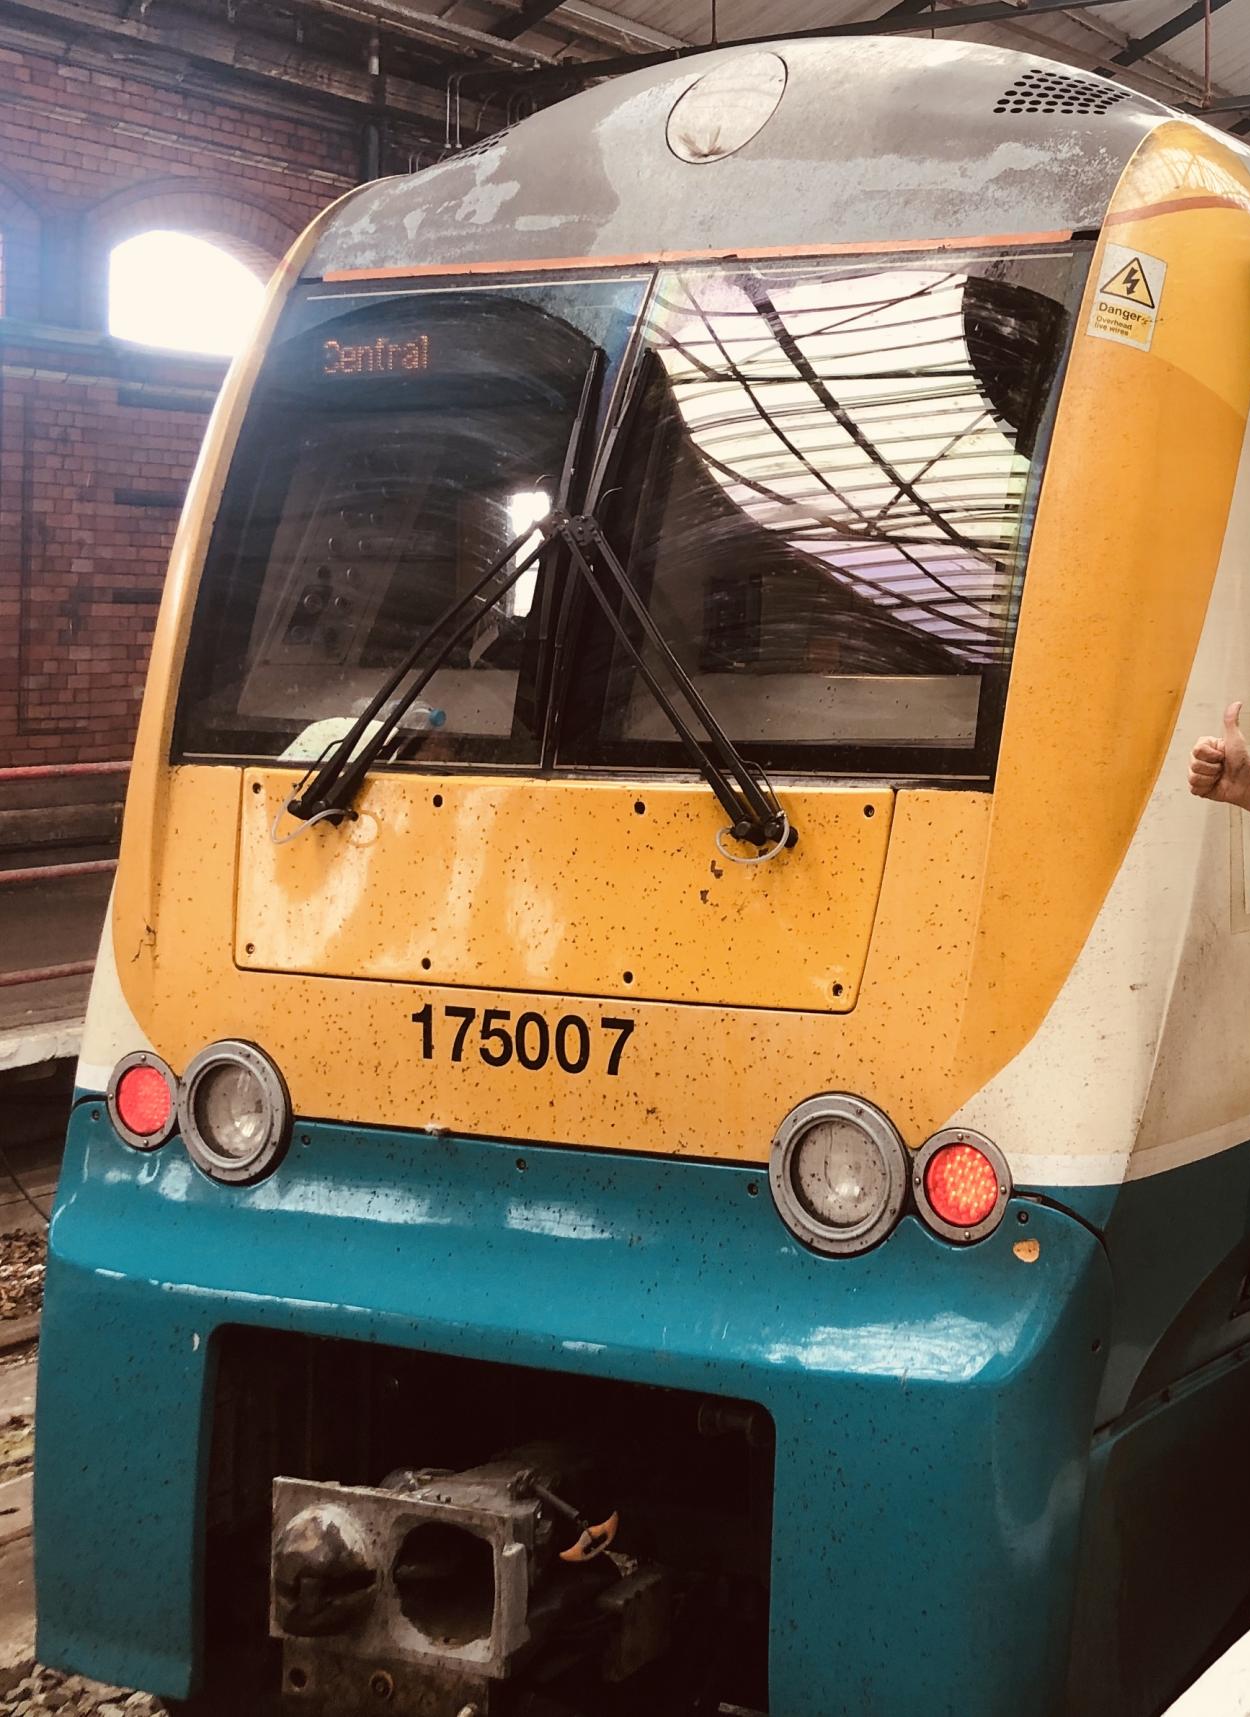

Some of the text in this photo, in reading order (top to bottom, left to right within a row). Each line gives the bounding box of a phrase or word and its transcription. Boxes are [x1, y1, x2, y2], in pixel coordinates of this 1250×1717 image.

[1098, 302, 1142, 322] Danger
[1094, 322, 1129, 336] live wires
[1096, 315, 1133, 330] Overhead
[411, 1003, 635, 1076] 175007
